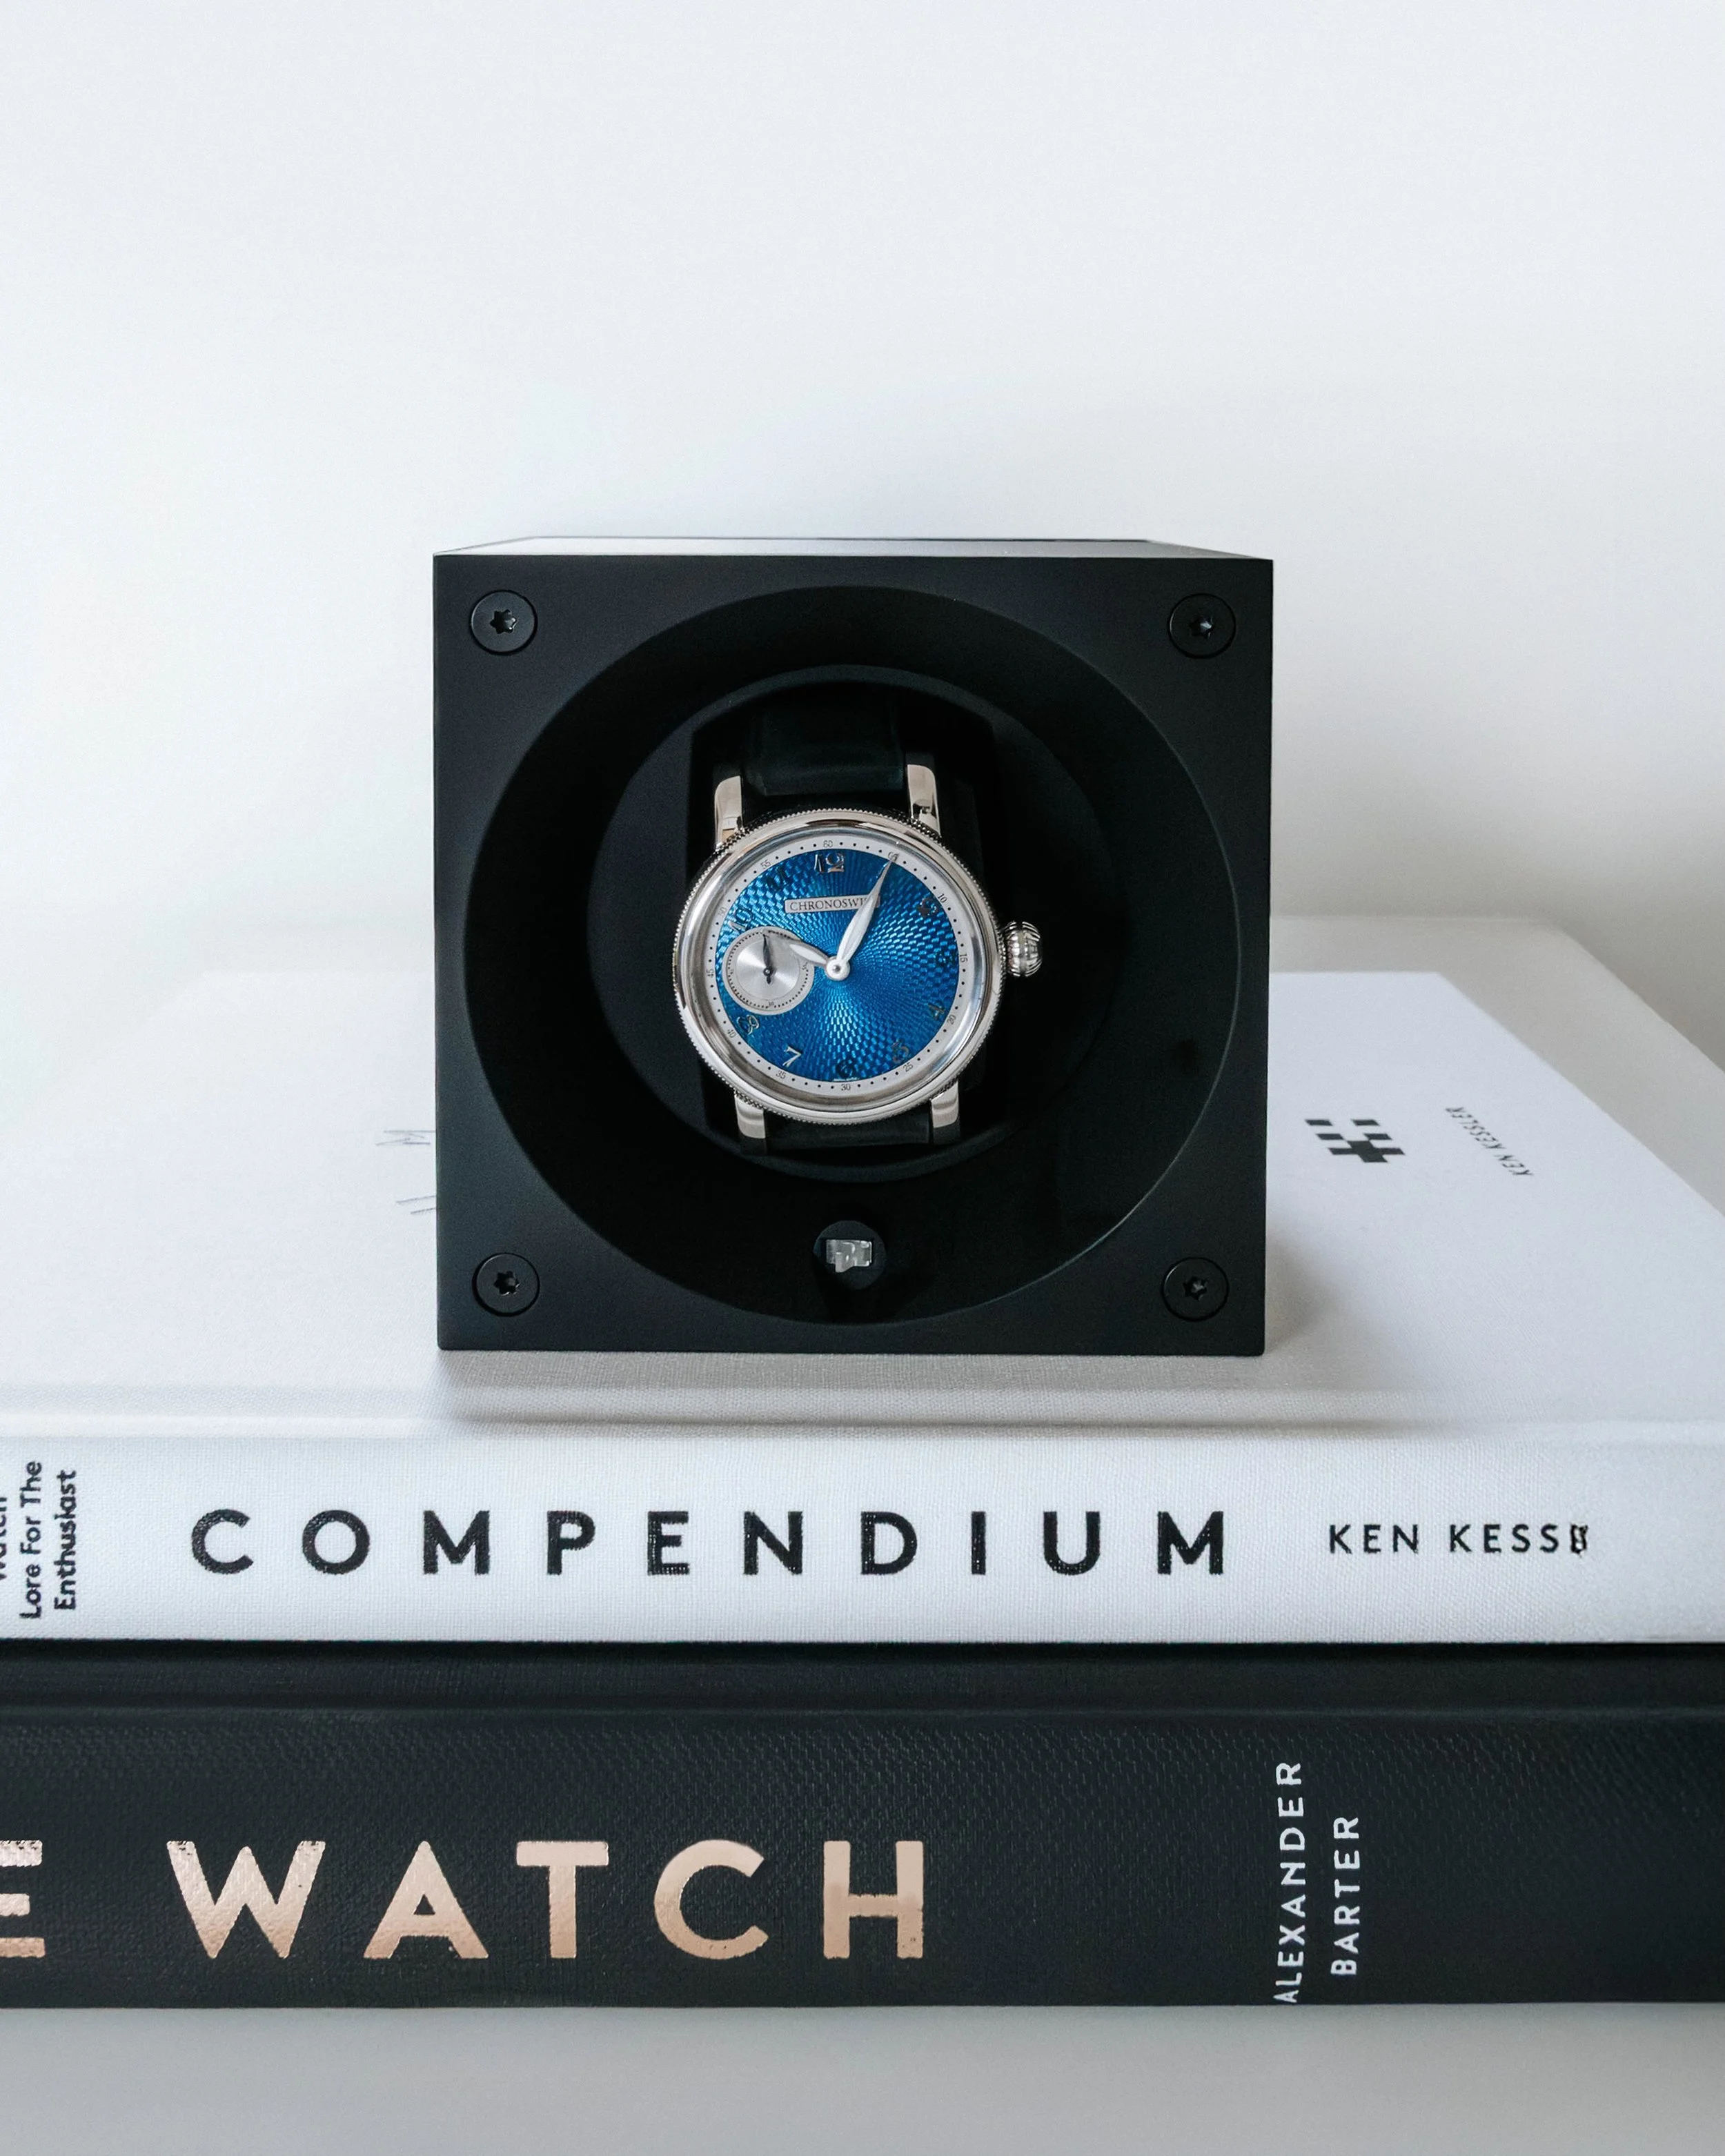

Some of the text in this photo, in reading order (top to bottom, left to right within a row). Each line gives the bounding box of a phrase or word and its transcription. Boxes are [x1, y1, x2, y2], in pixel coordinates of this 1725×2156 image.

[814, 853, 845, 873] 12
[789, 898, 868, 911] CHRONOSWI
[938, 893, 947, 903] 10
[959, 953, 968, 962] 15
[947, 1014, 956, 1025] 20
[782, 1046, 802, 1068] 7
[903, 1062, 914, 1073] 25
[776, 1070, 787, 1080] 35
[840, 1083, 851, 1091] 30
[1492, 1154, 1533, 1176] KEN
[19, 1461, 42, 1619] Lore For The
[54, 1470, 77, 1610] Enthusiast
[192, 1509, 1223, 1576] COMPENDIUM
[1329, 1523, 1419, 1554] KEN
[1273, 1763, 1306, 2003] ALEXANDER
[166, 1839, 924, 1961] WATCH
[1330, 1817, 1361, 1975] BARTER
